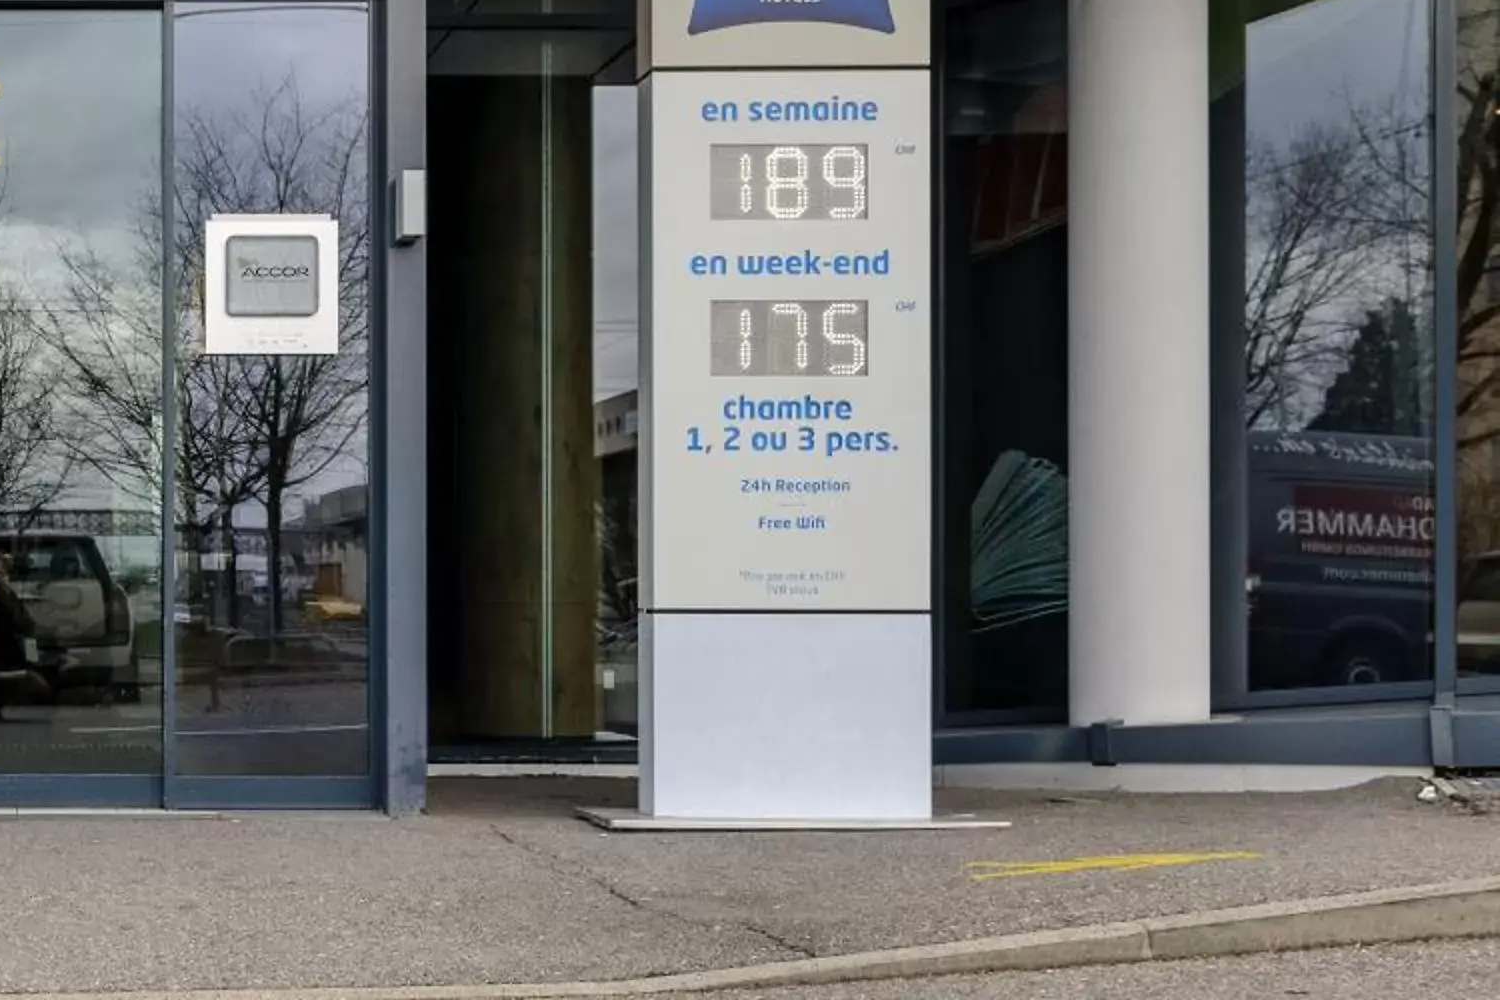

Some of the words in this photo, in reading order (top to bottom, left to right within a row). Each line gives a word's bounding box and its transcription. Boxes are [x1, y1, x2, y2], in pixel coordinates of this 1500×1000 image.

[701, 101, 739, 122] en
[748, 96, 879, 122] semaine
[739, 146, 866, 220] 189
[242, 265, 309, 279] ACCOR
[690, 254, 727, 275] en
[737, 249, 890, 275] week-end
[739, 303, 865, 375] 175
[723, 395, 853, 421] chambre
[686, 428, 713, 455] 1,
[723, 428, 741, 452] 2
[751, 432, 787, 452] ou
[798, 428, 816, 452] 3
[826, 432, 899, 456] pers.
[741, 478, 772, 493] 24h
[775, 478, 851, 496] Reception
[758, 515, 792, 530] Free
[796, 515, 826, 530] Wifi
